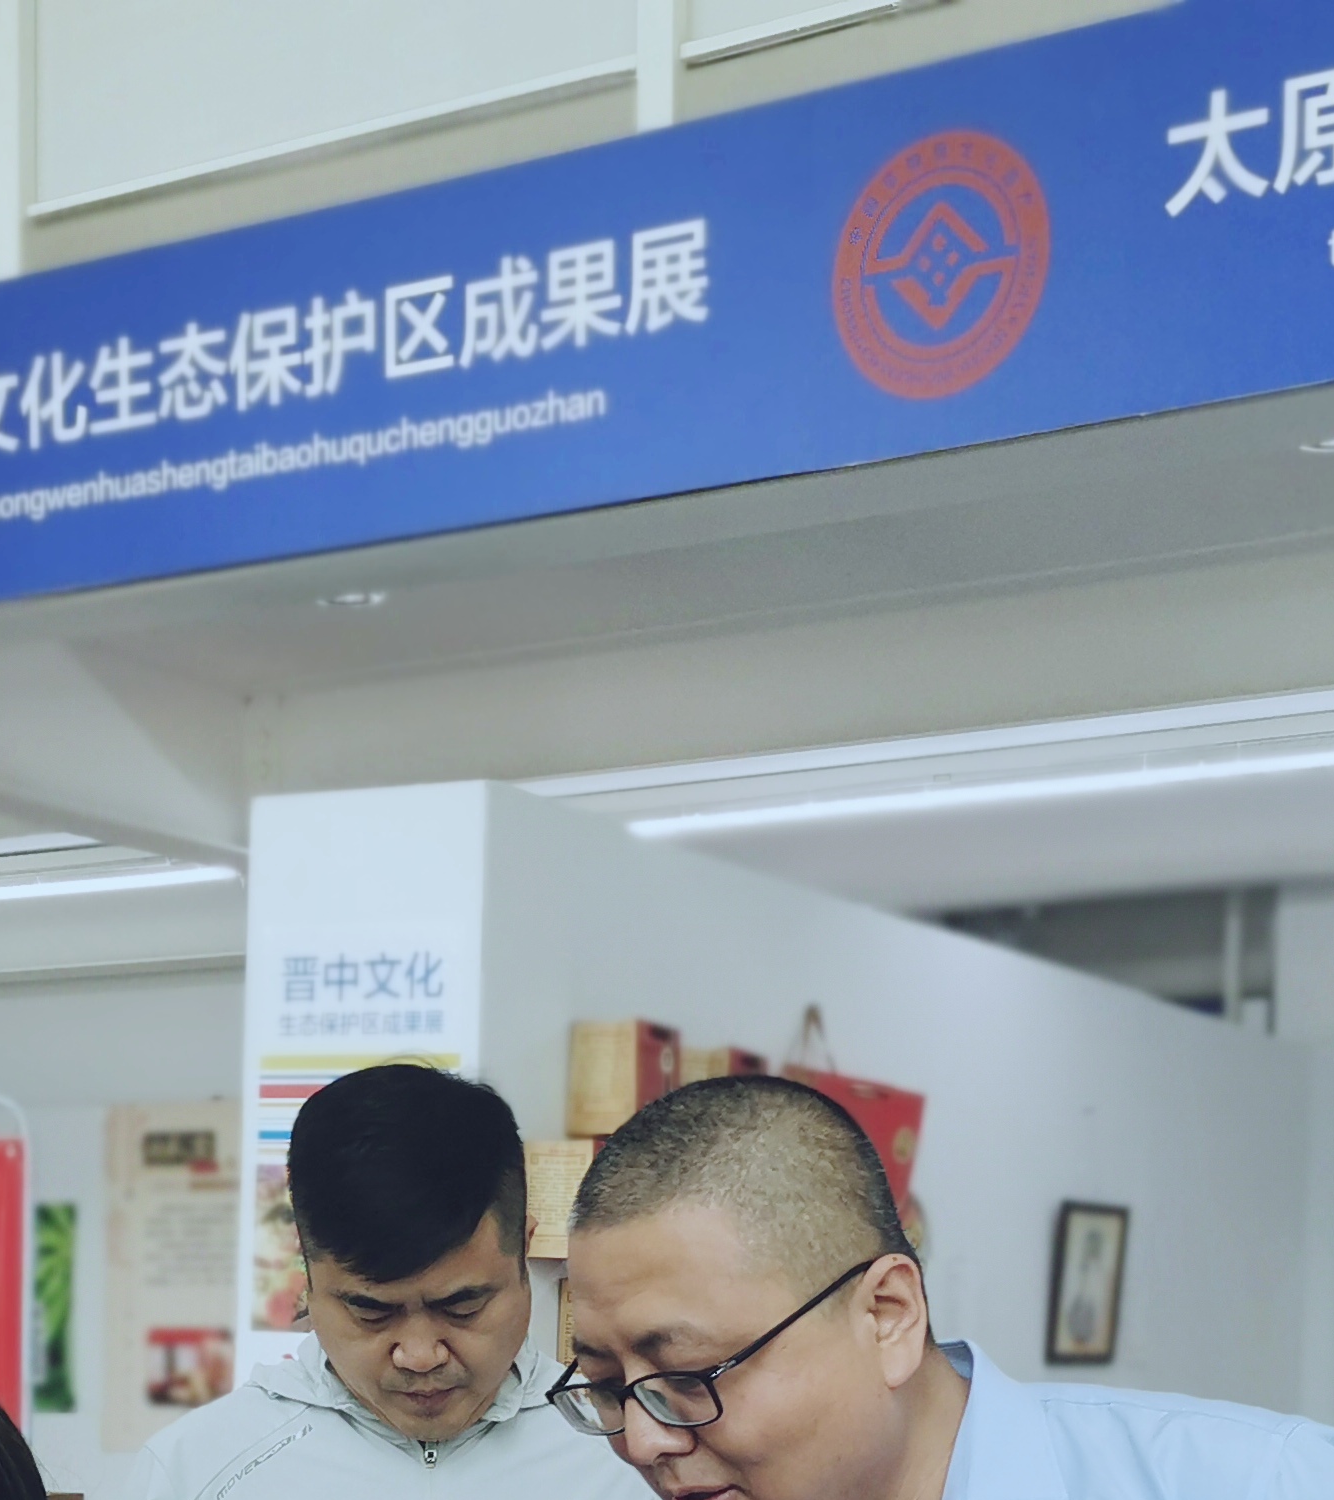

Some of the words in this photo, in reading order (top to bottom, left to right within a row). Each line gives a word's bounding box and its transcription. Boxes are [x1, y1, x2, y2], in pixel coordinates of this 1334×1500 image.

[281, 950, 445, 1004] 晋中文化
[278, 1010, 445, 1037] 生态保护区成果展
